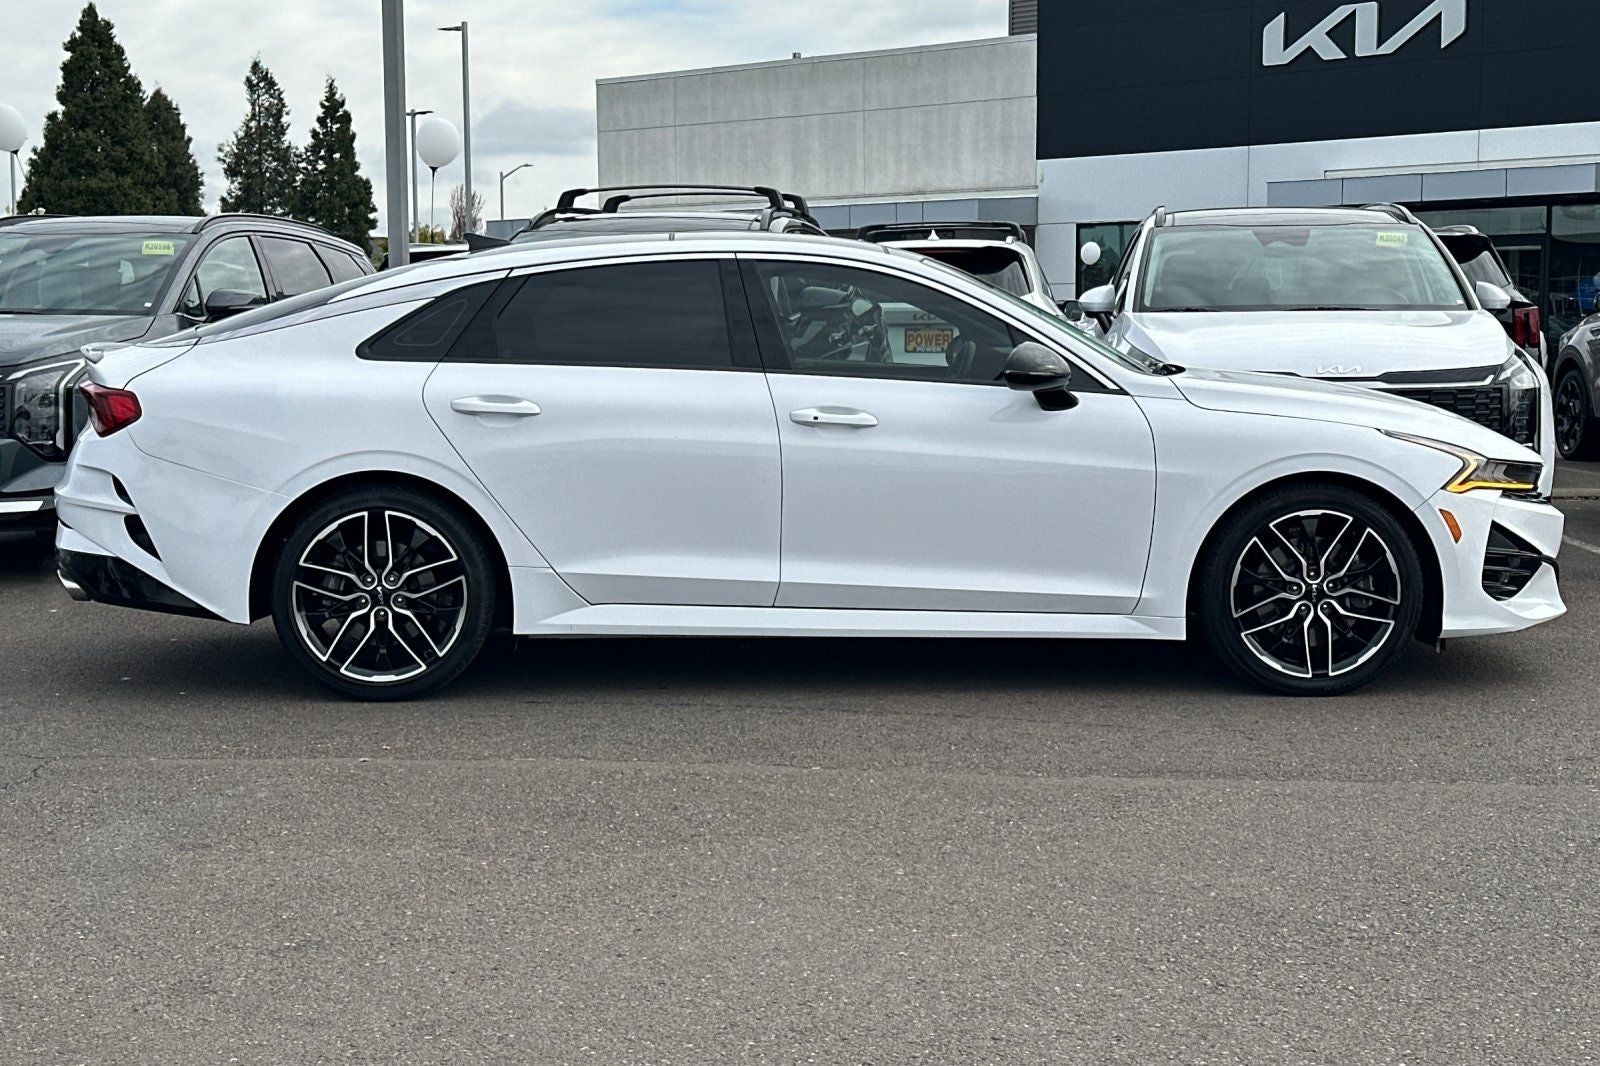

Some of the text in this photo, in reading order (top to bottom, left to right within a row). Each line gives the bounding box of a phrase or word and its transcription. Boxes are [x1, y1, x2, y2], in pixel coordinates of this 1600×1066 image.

[1263, 0, 1466, 67] KIA
[907, 333, 950, 346] POWER
[1316, 365, 1362, 375] KIA
